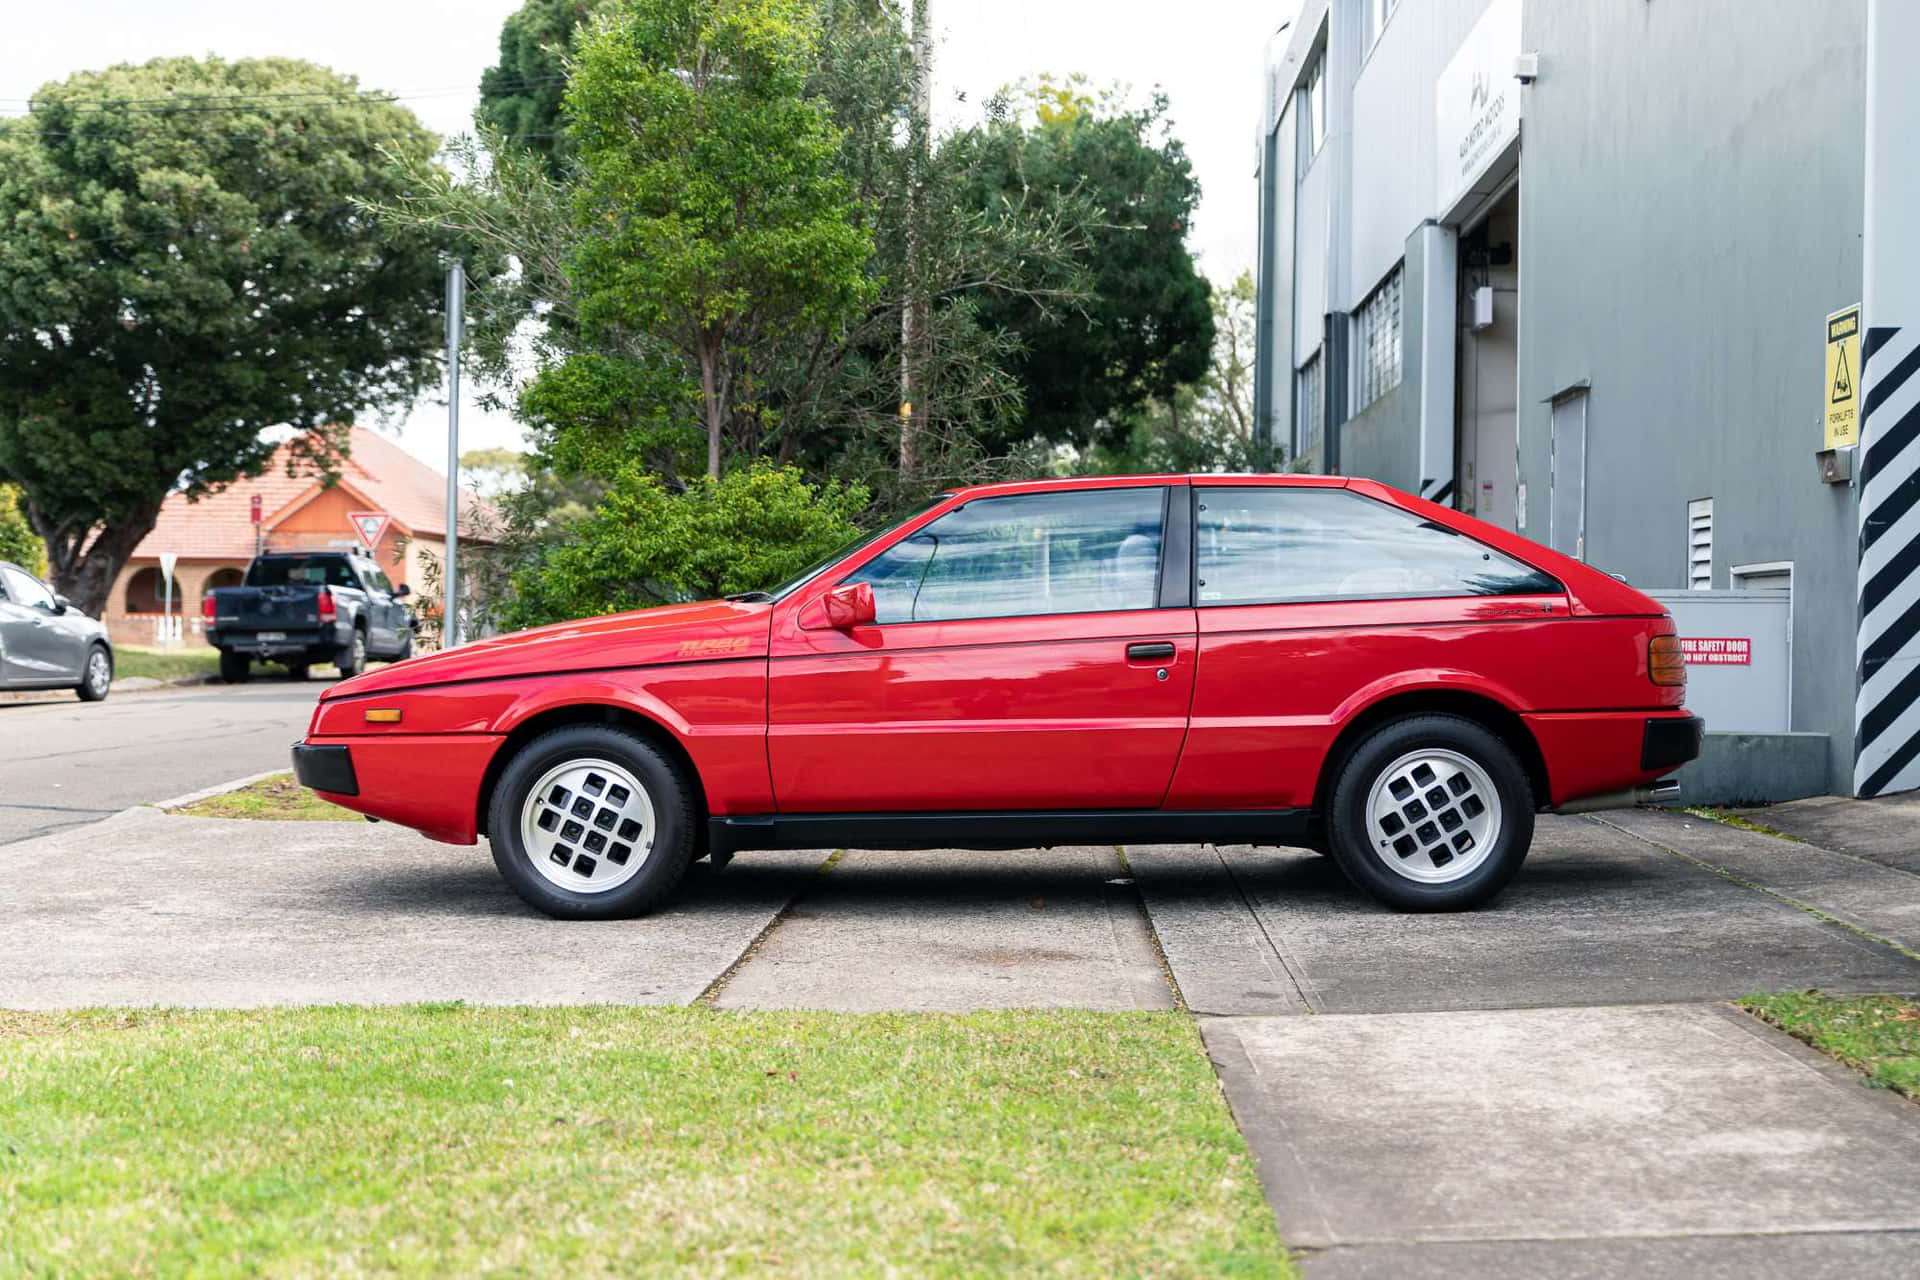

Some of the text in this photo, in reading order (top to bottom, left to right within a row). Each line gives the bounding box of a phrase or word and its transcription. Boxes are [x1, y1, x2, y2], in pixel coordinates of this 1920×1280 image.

[1829, 408, 1854, 424] FORKLIFTS
[1839, 424, 1849, 436] USE
[1681, 640, 1748, 652] FIRE SAFETY DOOR
[1693, 654, 1708, 662] NOT
[1708, 654, 1748, 662] OBSTRUCT
